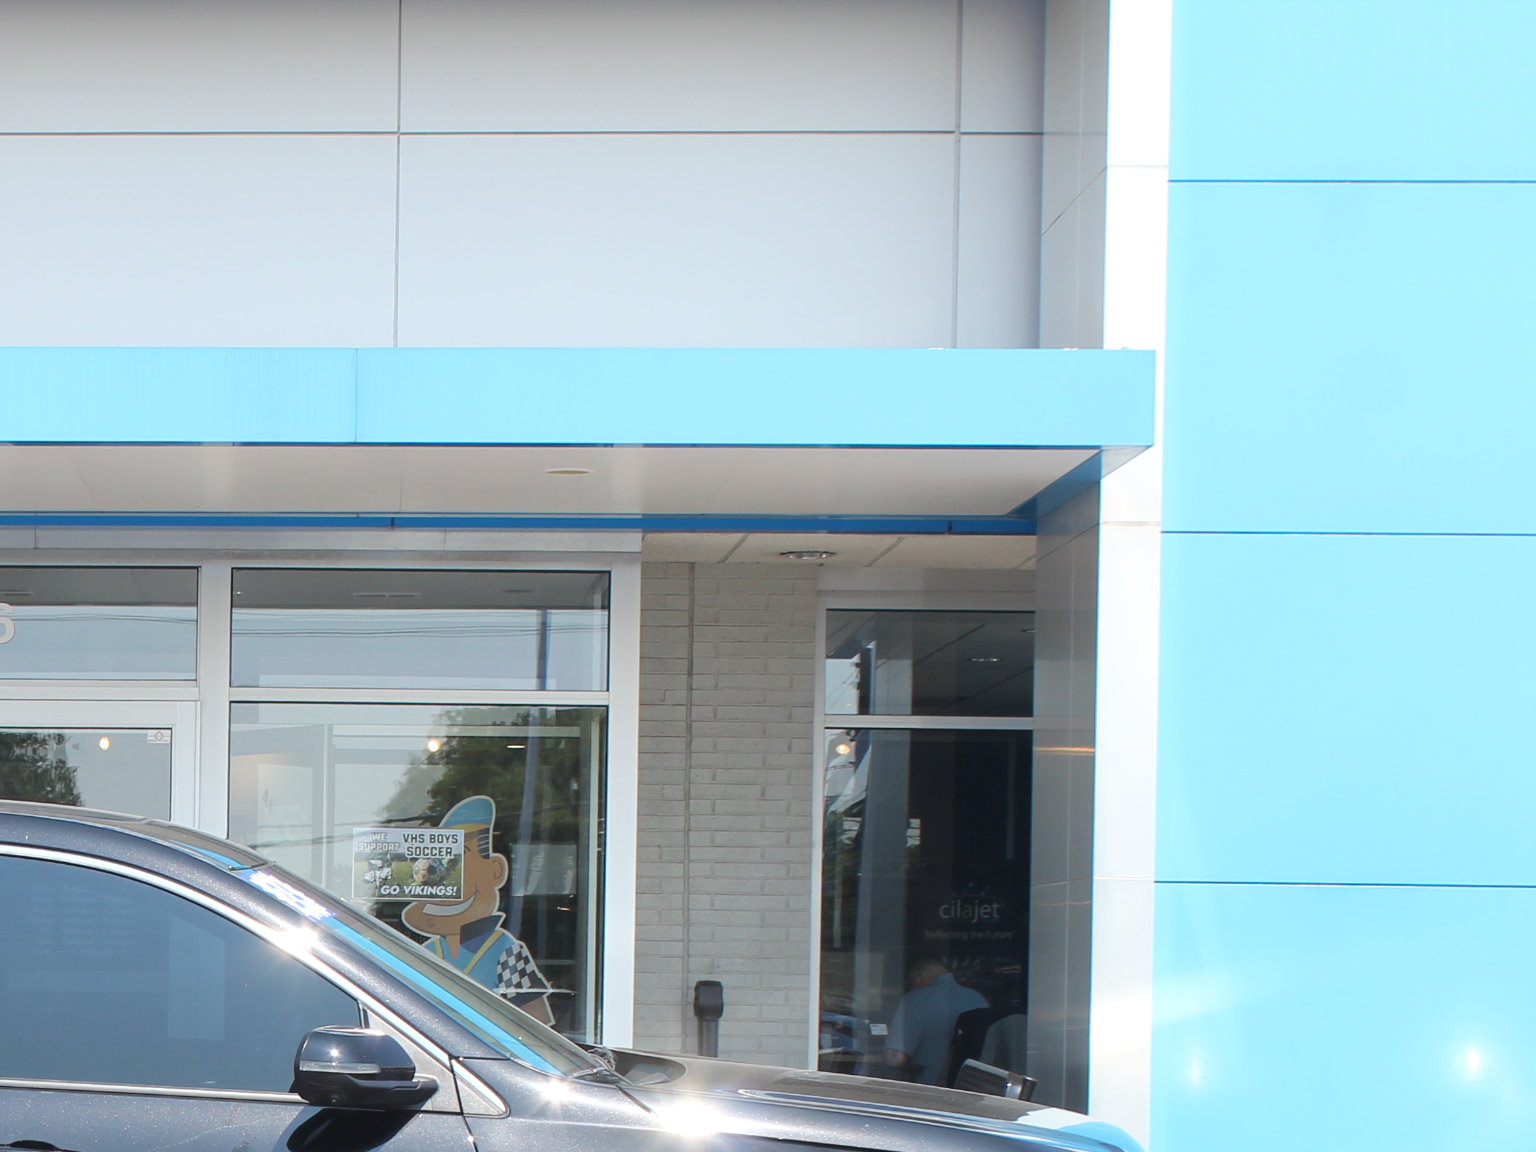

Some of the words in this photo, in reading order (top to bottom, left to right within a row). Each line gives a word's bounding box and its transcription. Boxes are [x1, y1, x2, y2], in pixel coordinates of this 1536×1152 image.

[370, 832, 387, 841] WE
[403, 833, 425, 844] VHS
[429, 834, 458, 844] BOYS
[358, 842, 400, 851] SUPPORT
[406, 846, 453, 857] SOCCER
[381, 885, 400, 895] GO
[404, 885, 457, 896] VIKINGS!
[939, 899, 1000, 923] cilajet
